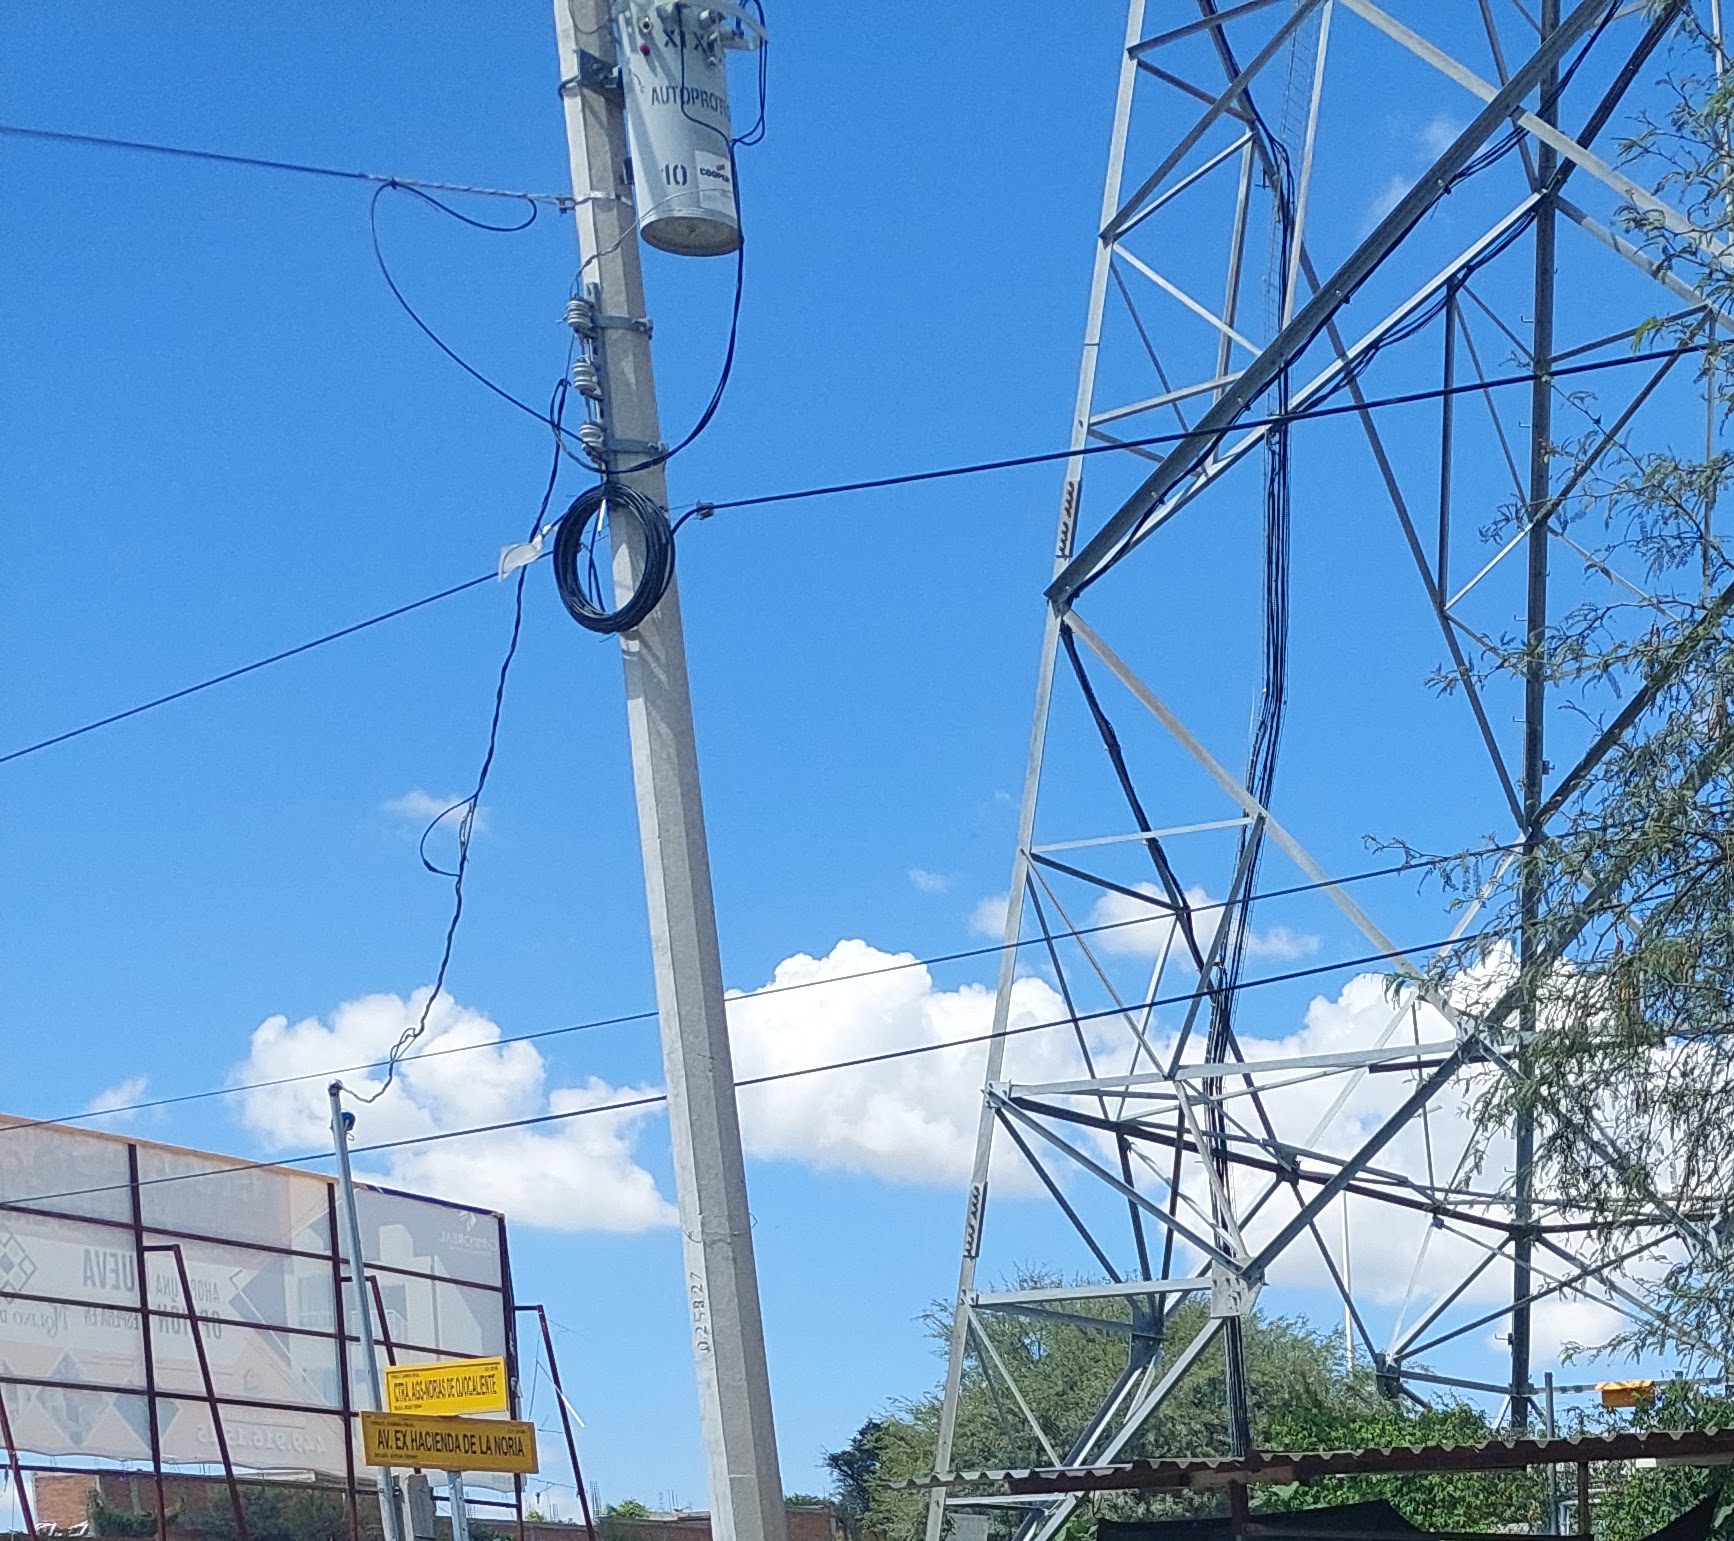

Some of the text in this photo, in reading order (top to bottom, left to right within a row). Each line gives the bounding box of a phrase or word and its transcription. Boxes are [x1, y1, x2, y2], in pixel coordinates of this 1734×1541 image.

[663, 163, 688, 187] 10
[446, 1377, 455, 1399] DE
[377, 1428, 526, 1458] AV. EX HACIENDA DE LA NORIA
